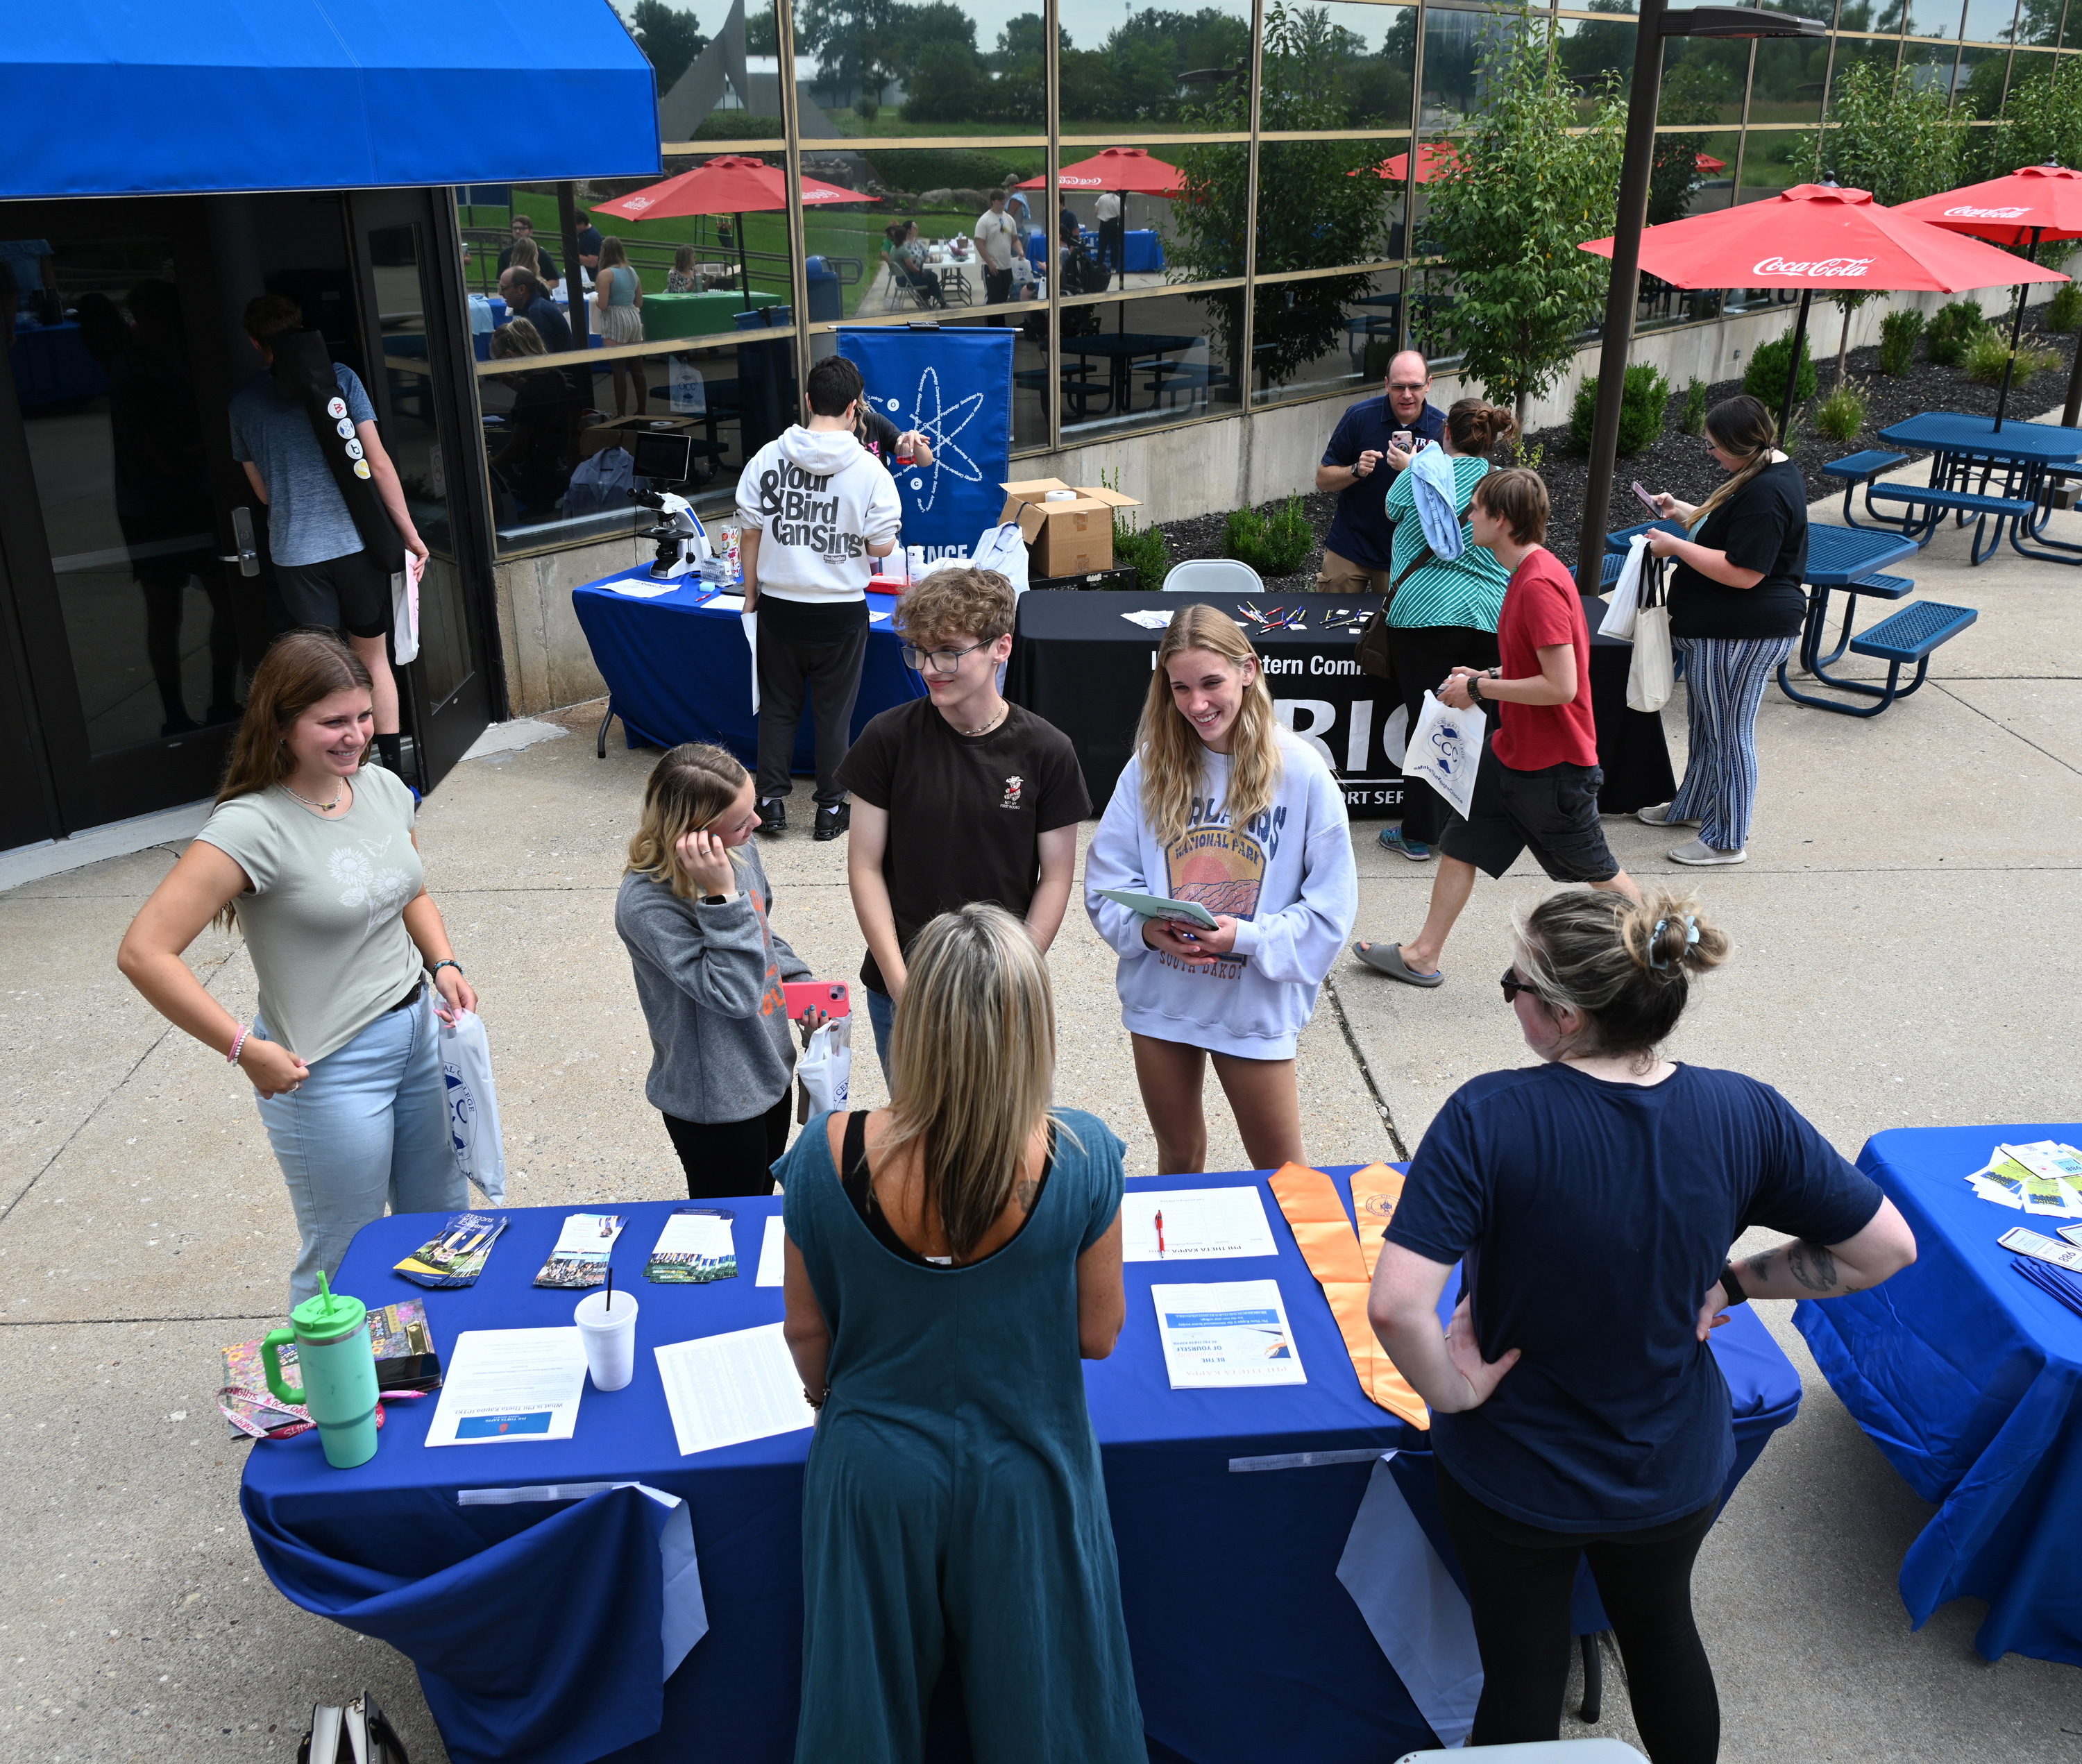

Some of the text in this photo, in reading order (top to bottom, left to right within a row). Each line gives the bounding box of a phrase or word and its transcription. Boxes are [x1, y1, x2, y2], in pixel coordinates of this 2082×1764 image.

[1944, 205, 2033, 219] Coca-Cola
[1753, 256, 1877, 277] Coca-Cola
[777, 459, 834, 493] Your
[760, 469, 786, 516] &
[785, 491, 840, 525] Bird
[1310, 655, 1367, 675] Com
[1432, 733, 1458, 763] OCC
[457, 1220, 489, 1230] EMBRACE
[466, 1213, 494, 1223] SUCCESS
[2058, 1251, 2076, 1262] 988
[225, 1387, 258, 1401] KNIGHTS
[271, 1400, 291, 1410] OCC
[231, 1414, 255, 1432] KNIGHTS
